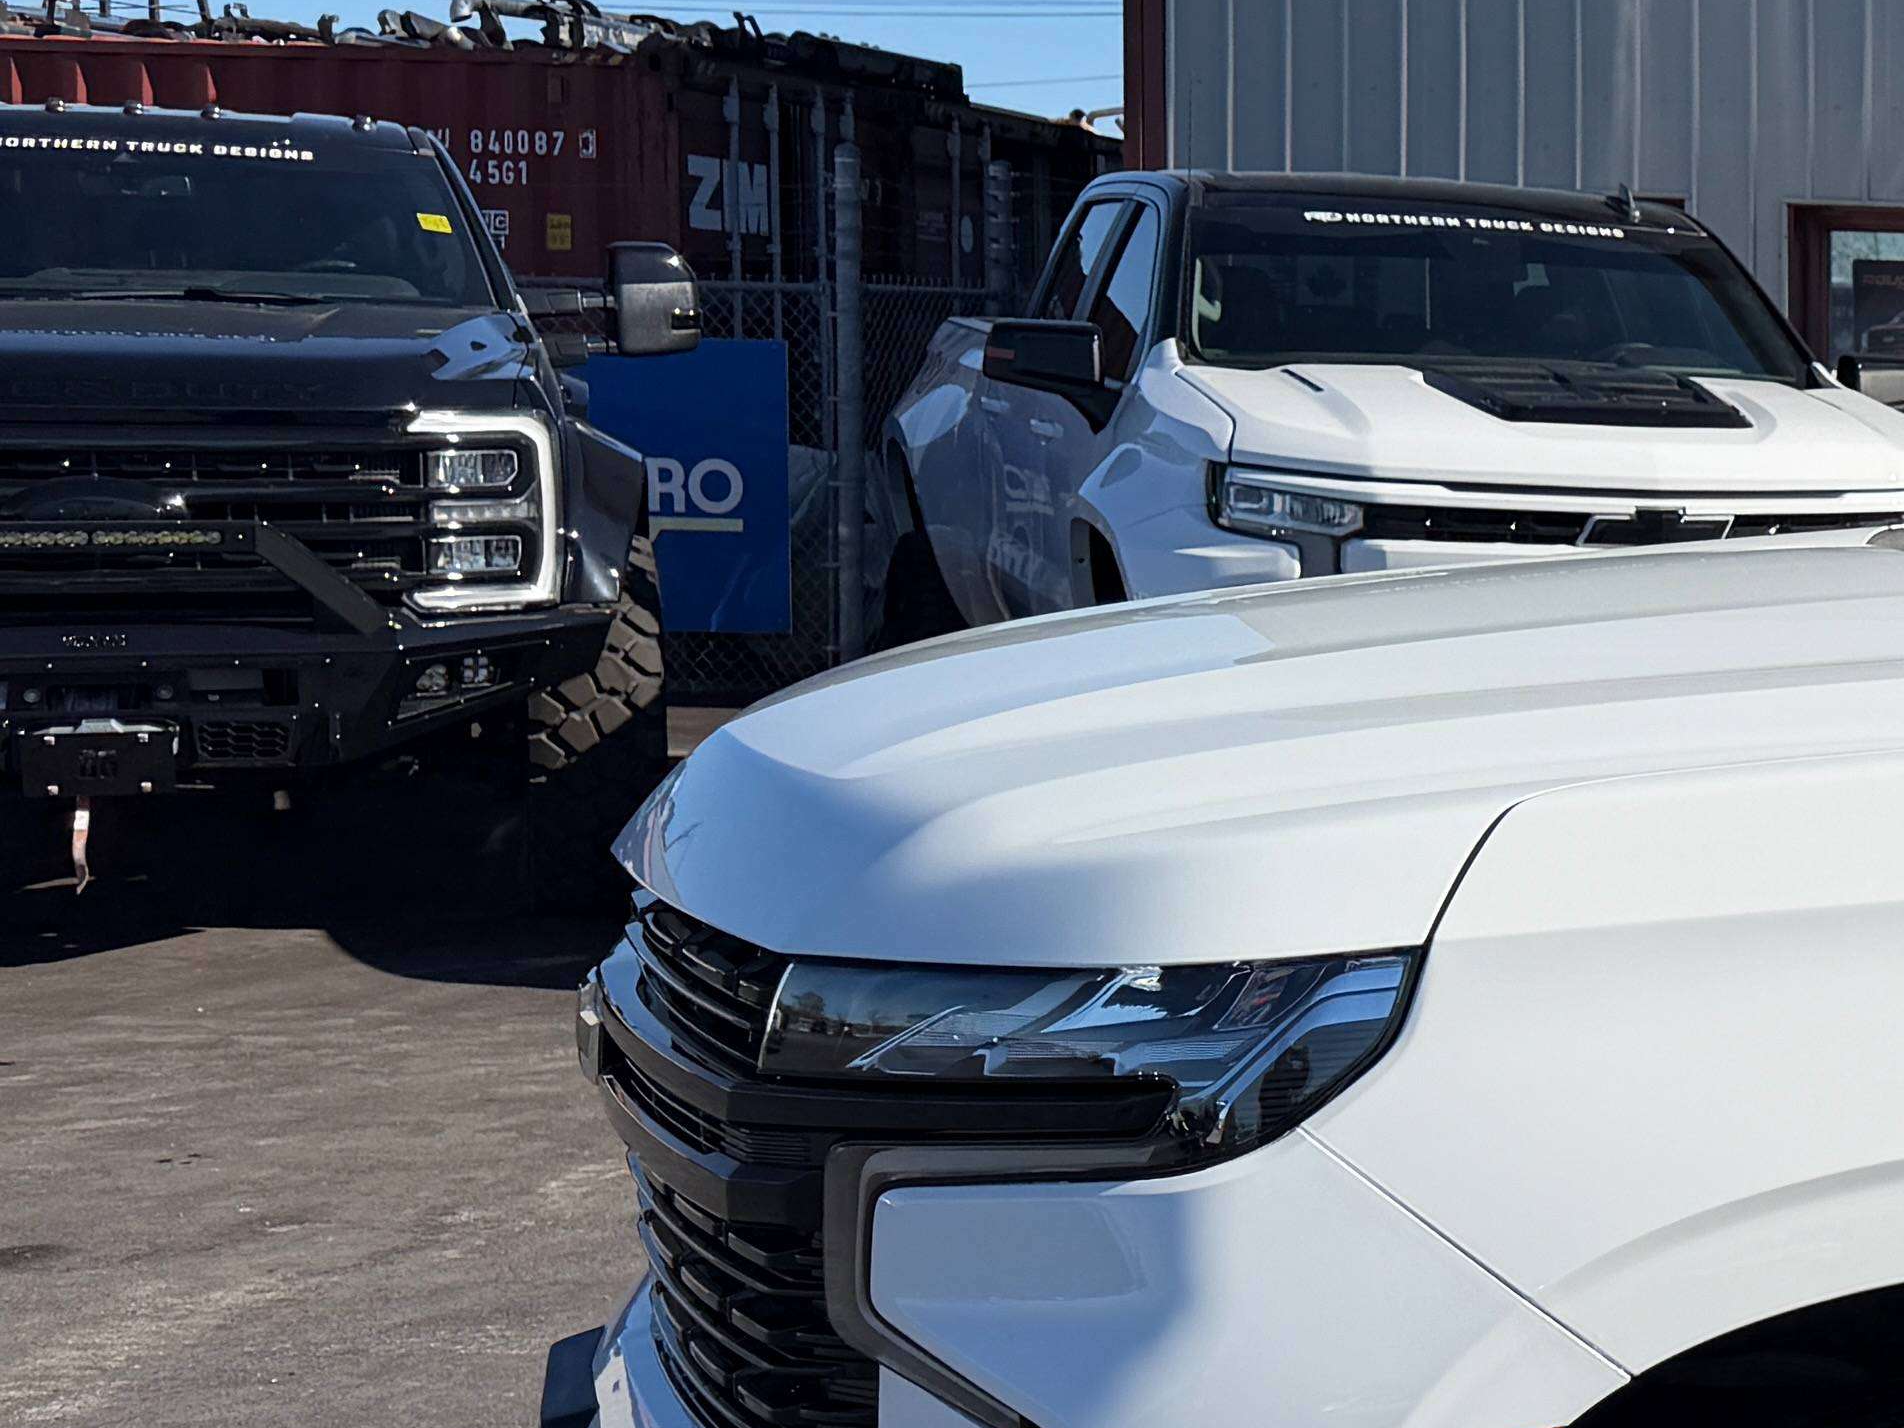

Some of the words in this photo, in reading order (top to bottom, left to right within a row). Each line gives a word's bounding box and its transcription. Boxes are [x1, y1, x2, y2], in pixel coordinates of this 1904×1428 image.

[126, 140, 203, 155] TRUCK
[470, 129, 565, 156] 840087
[687, 153, 770, 237] ZIM
[1345, 212, 1461, 228] NORTHERN
[1464, 218, 1534, 232] TRUCK
